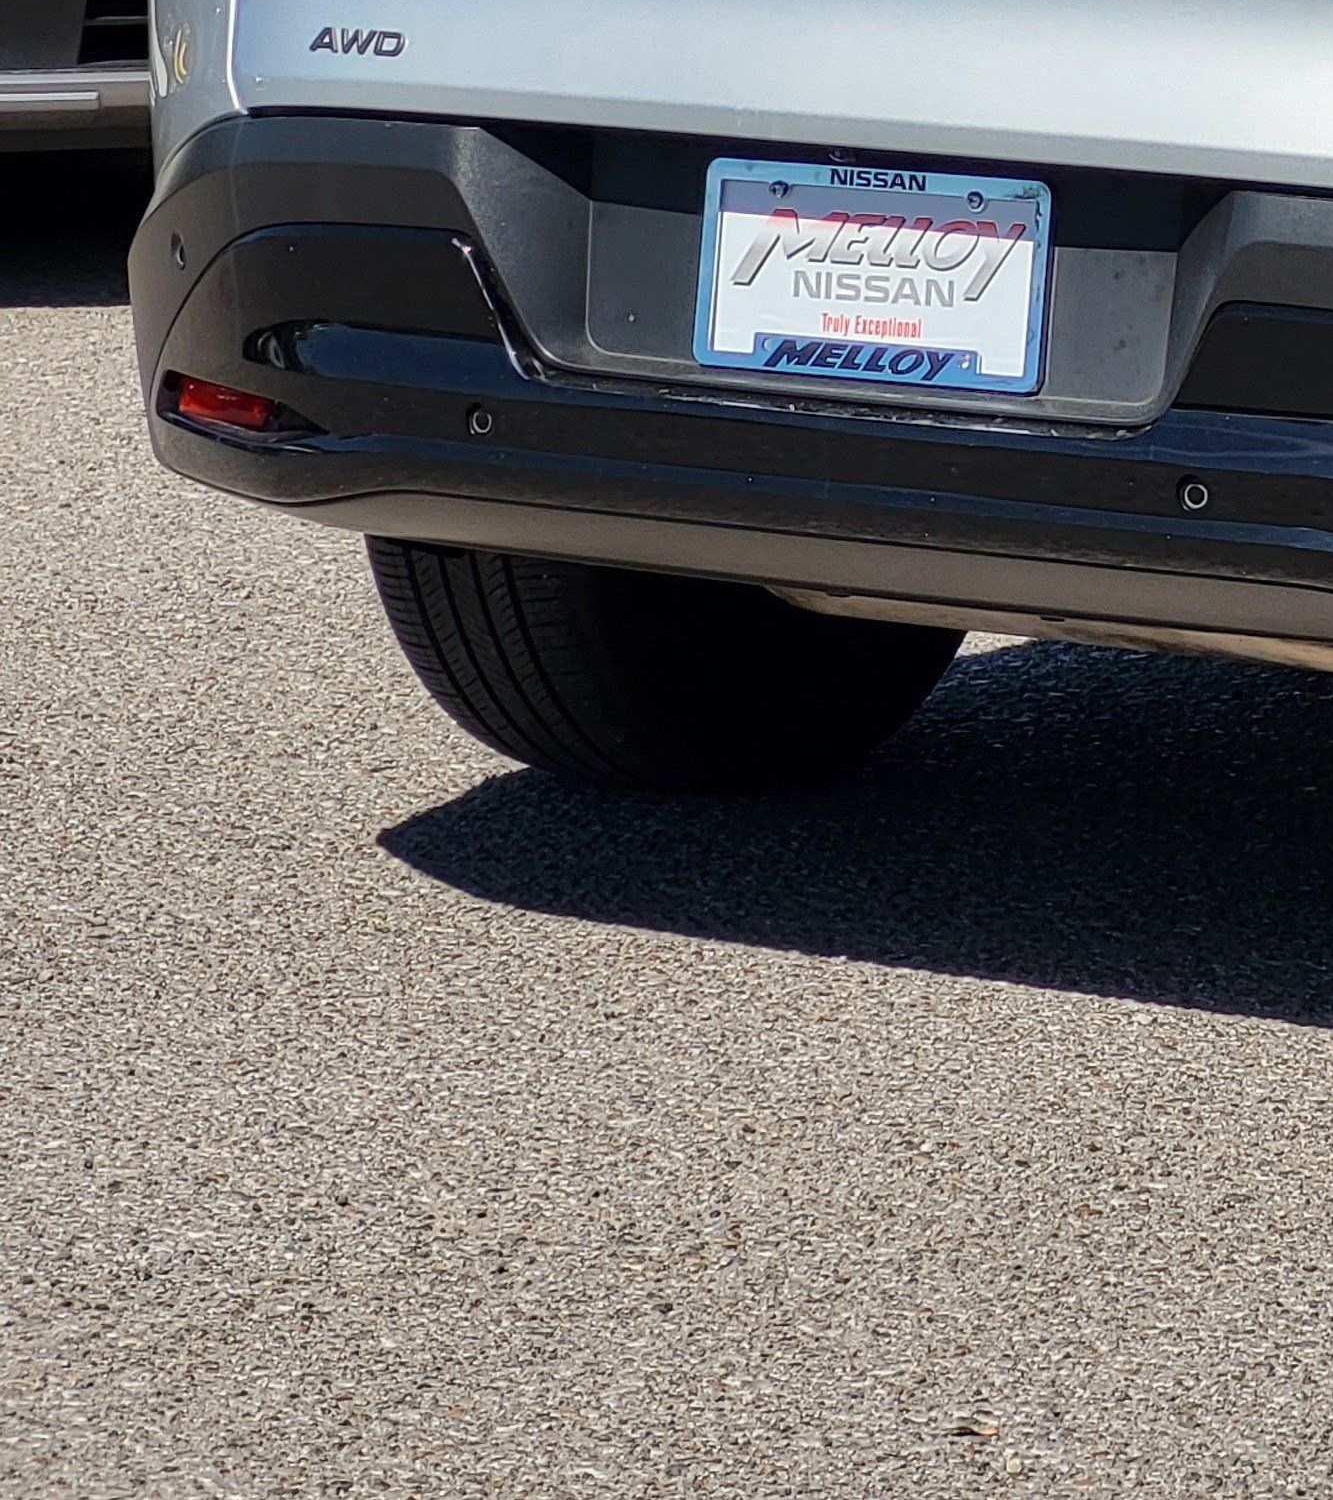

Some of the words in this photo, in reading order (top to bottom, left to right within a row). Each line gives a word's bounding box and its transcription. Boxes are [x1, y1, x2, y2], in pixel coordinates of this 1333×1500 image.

[309, 27, 406, 57] AWD
[830, 168, 926, 192] NISSAN
[731, 208, 1027, 302] MELLOY
[793, 270, 955, 307] NISSAN
[821, 313, 850, 336] Truly
[854, 315, 922, 339] Exceptional
[763, 340, 955, 381] MELLOY
